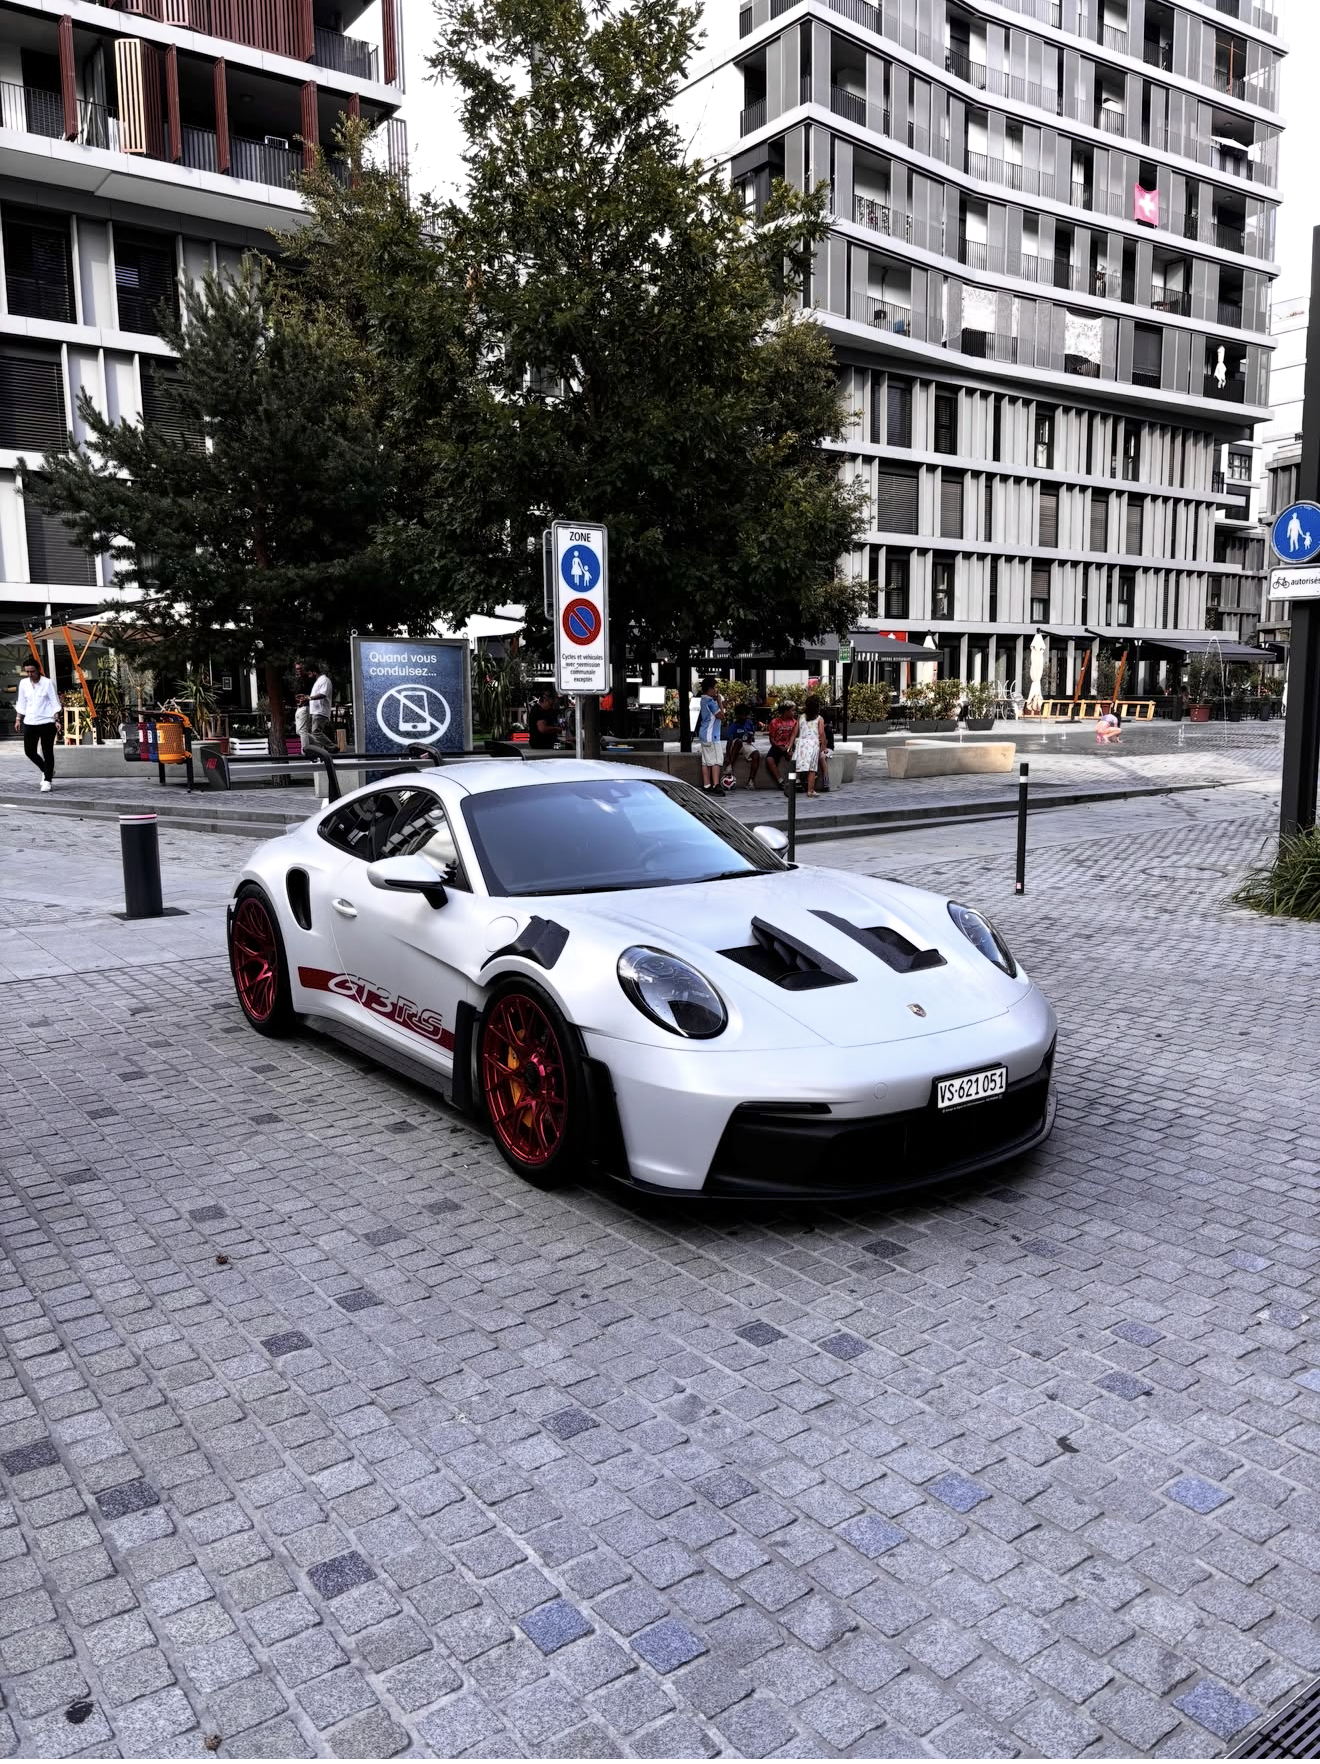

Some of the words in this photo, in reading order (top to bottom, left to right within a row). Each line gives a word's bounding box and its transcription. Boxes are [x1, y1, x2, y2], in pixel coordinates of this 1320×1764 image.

[569, 531, 592, 543] ZONE
[369, 651, 408, 664] Quand
[410, 654, 437, 664] vous
[562, 653, 576, 661] Cycles
[369, 665, 437, 677] conduisez...
